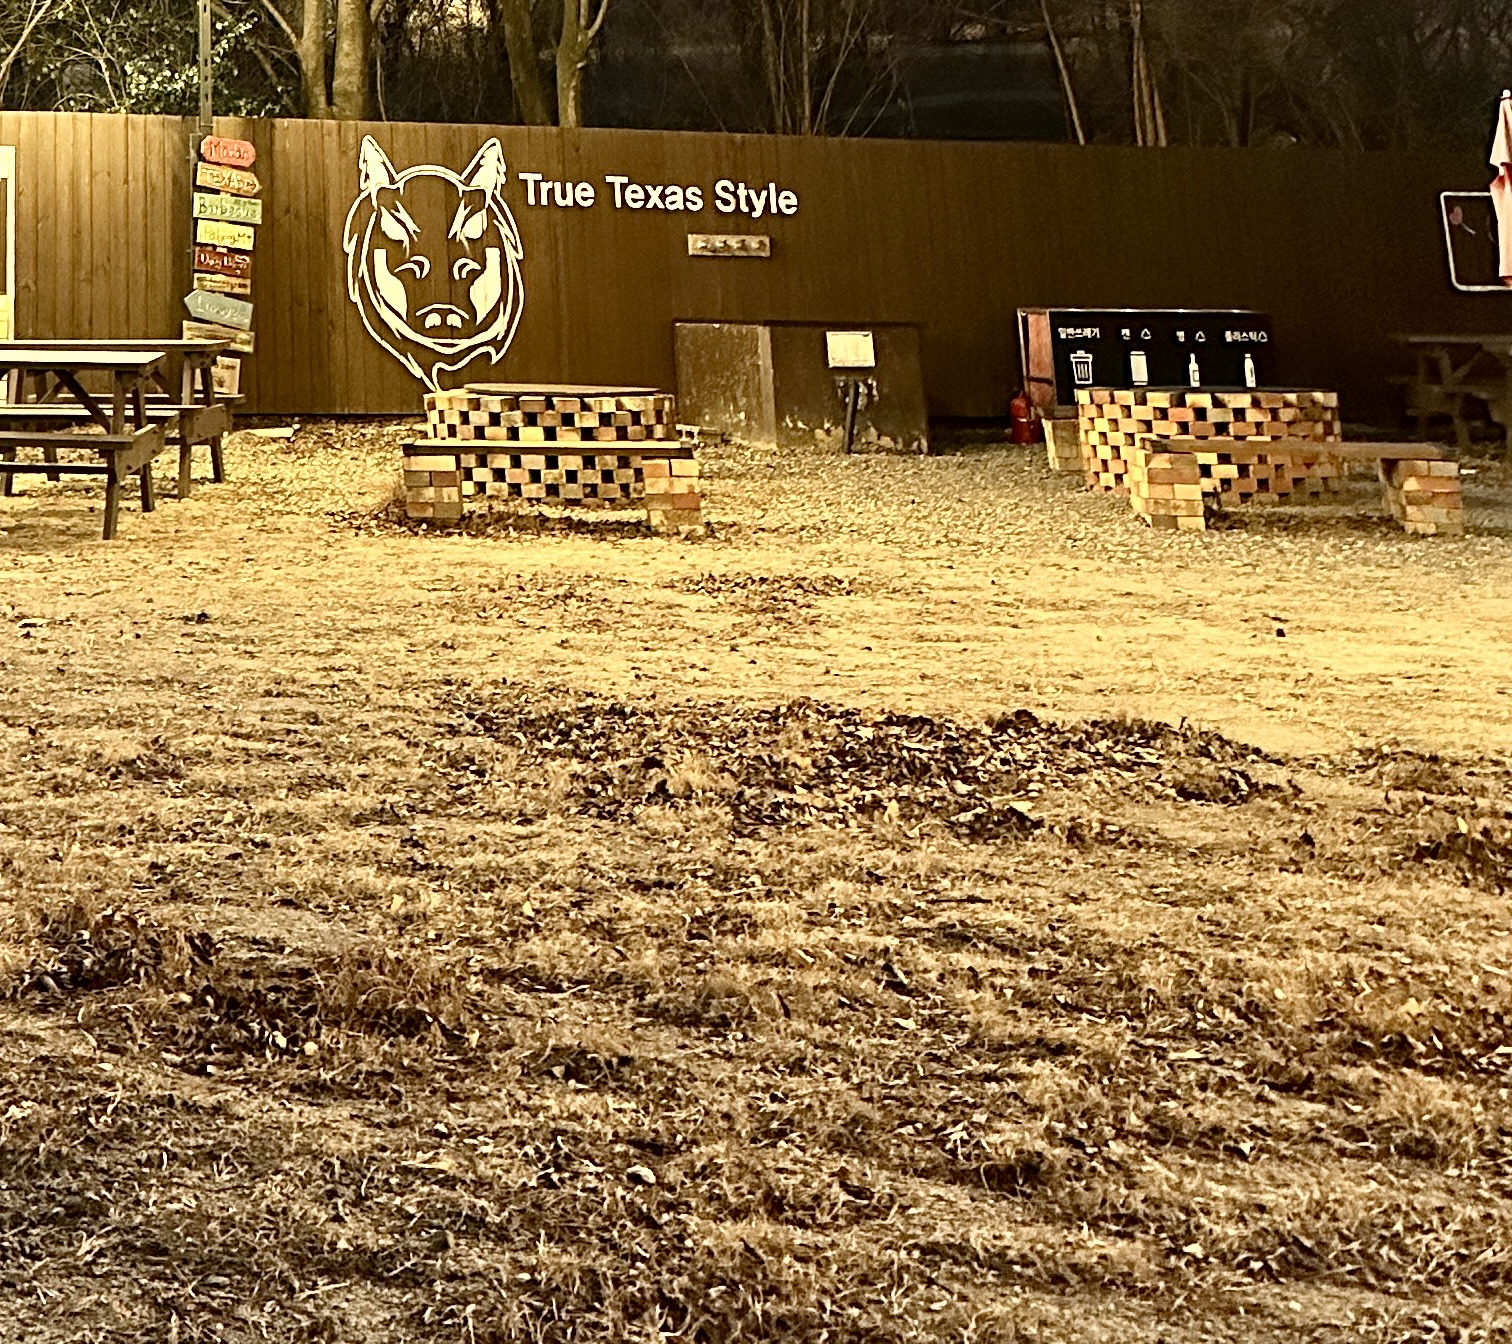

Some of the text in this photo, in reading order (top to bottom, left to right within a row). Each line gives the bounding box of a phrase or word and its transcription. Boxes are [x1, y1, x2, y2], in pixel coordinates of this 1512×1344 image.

[518, 172, 799, 218] True Texas Style
